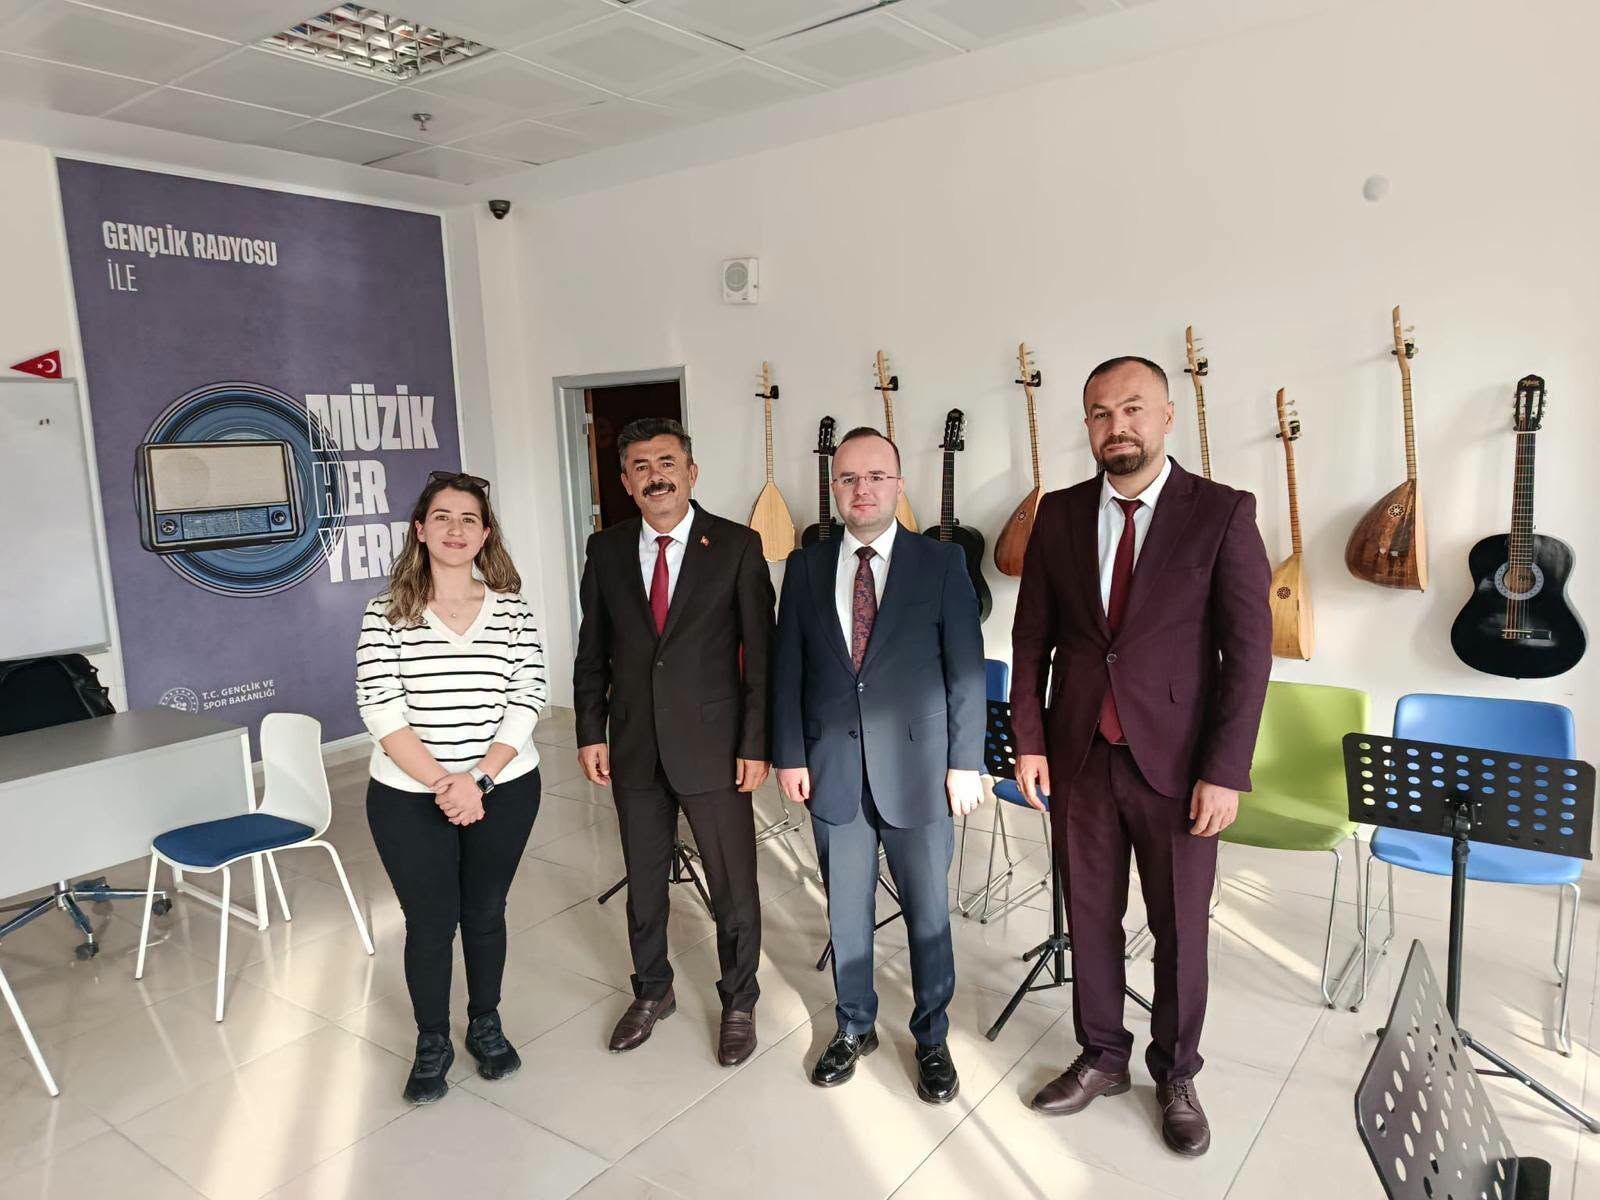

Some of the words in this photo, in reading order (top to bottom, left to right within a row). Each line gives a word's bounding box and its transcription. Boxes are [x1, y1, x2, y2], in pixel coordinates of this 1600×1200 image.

[102, 221, 189, 257] GENÇLİK
[191, 231, 278, 267] RADYOSU
[107, 258, 138, 292] İLE
[305, 383, 439, 451] MÜZİK
[312, 459, 390, 519] HER
[202, 690, 219, 700] T.C.
[221, 682, 260, 696] GENÇLİK
[262, 679, 274, 688] VE
[203, 699, 227, 710] SPOR
[229, 688, 275, 705] BAKANLIĞI
